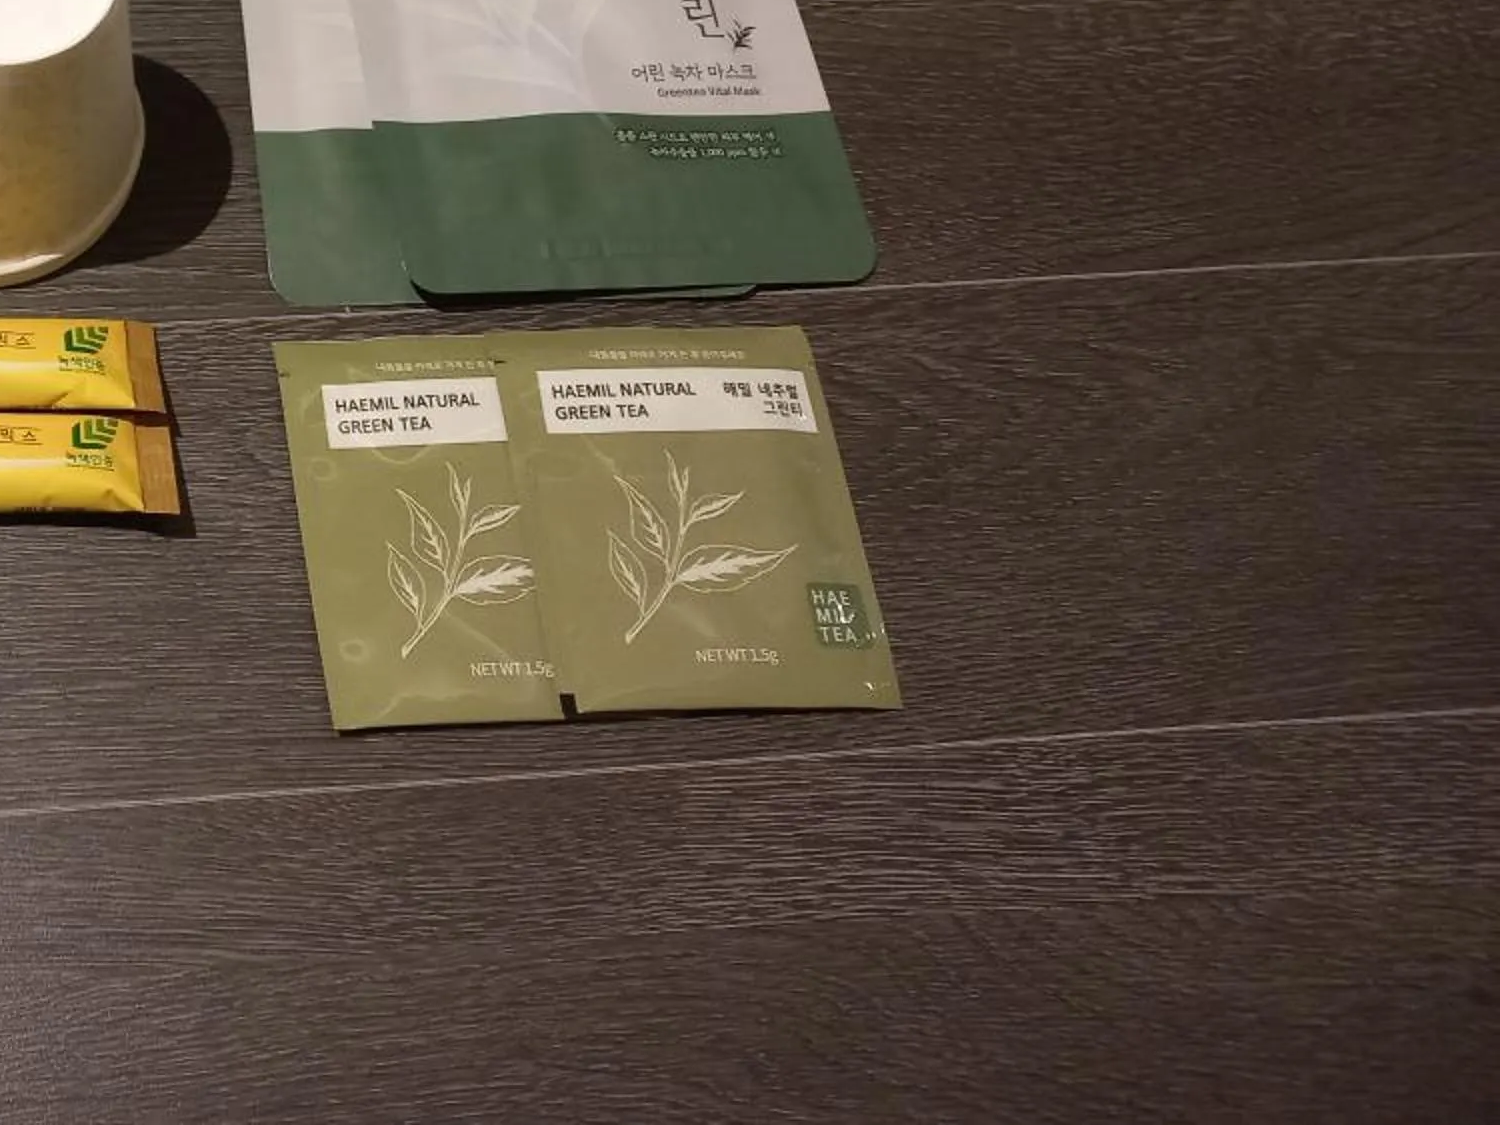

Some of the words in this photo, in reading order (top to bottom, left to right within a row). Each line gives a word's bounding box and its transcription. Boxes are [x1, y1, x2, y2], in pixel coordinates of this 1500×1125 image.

[631, 63, 665, 82] 어린
[669, 64, 703, 82] 녹차
[707, 63, 757, 80] 마스크
[551, 383, 617, 399] HAEMIL
[620, 382, 698, 398] NATURAL
[722, 382, 752, 398] 해밀
[335, 398, 400, 413] HAEMIL
[404, 392, 480, 410] NATURAL
[764, 400, 804, 418] 그린티
[555, 405, 612, 420] GREEN
[615, 403, 650, 418] TEA
[338, 418, 394, 434] GREEN
[401, 416, 432, 431] TEA
[811, 590, 851, 607] HAE
[819, 626, 858, 642] TEA
